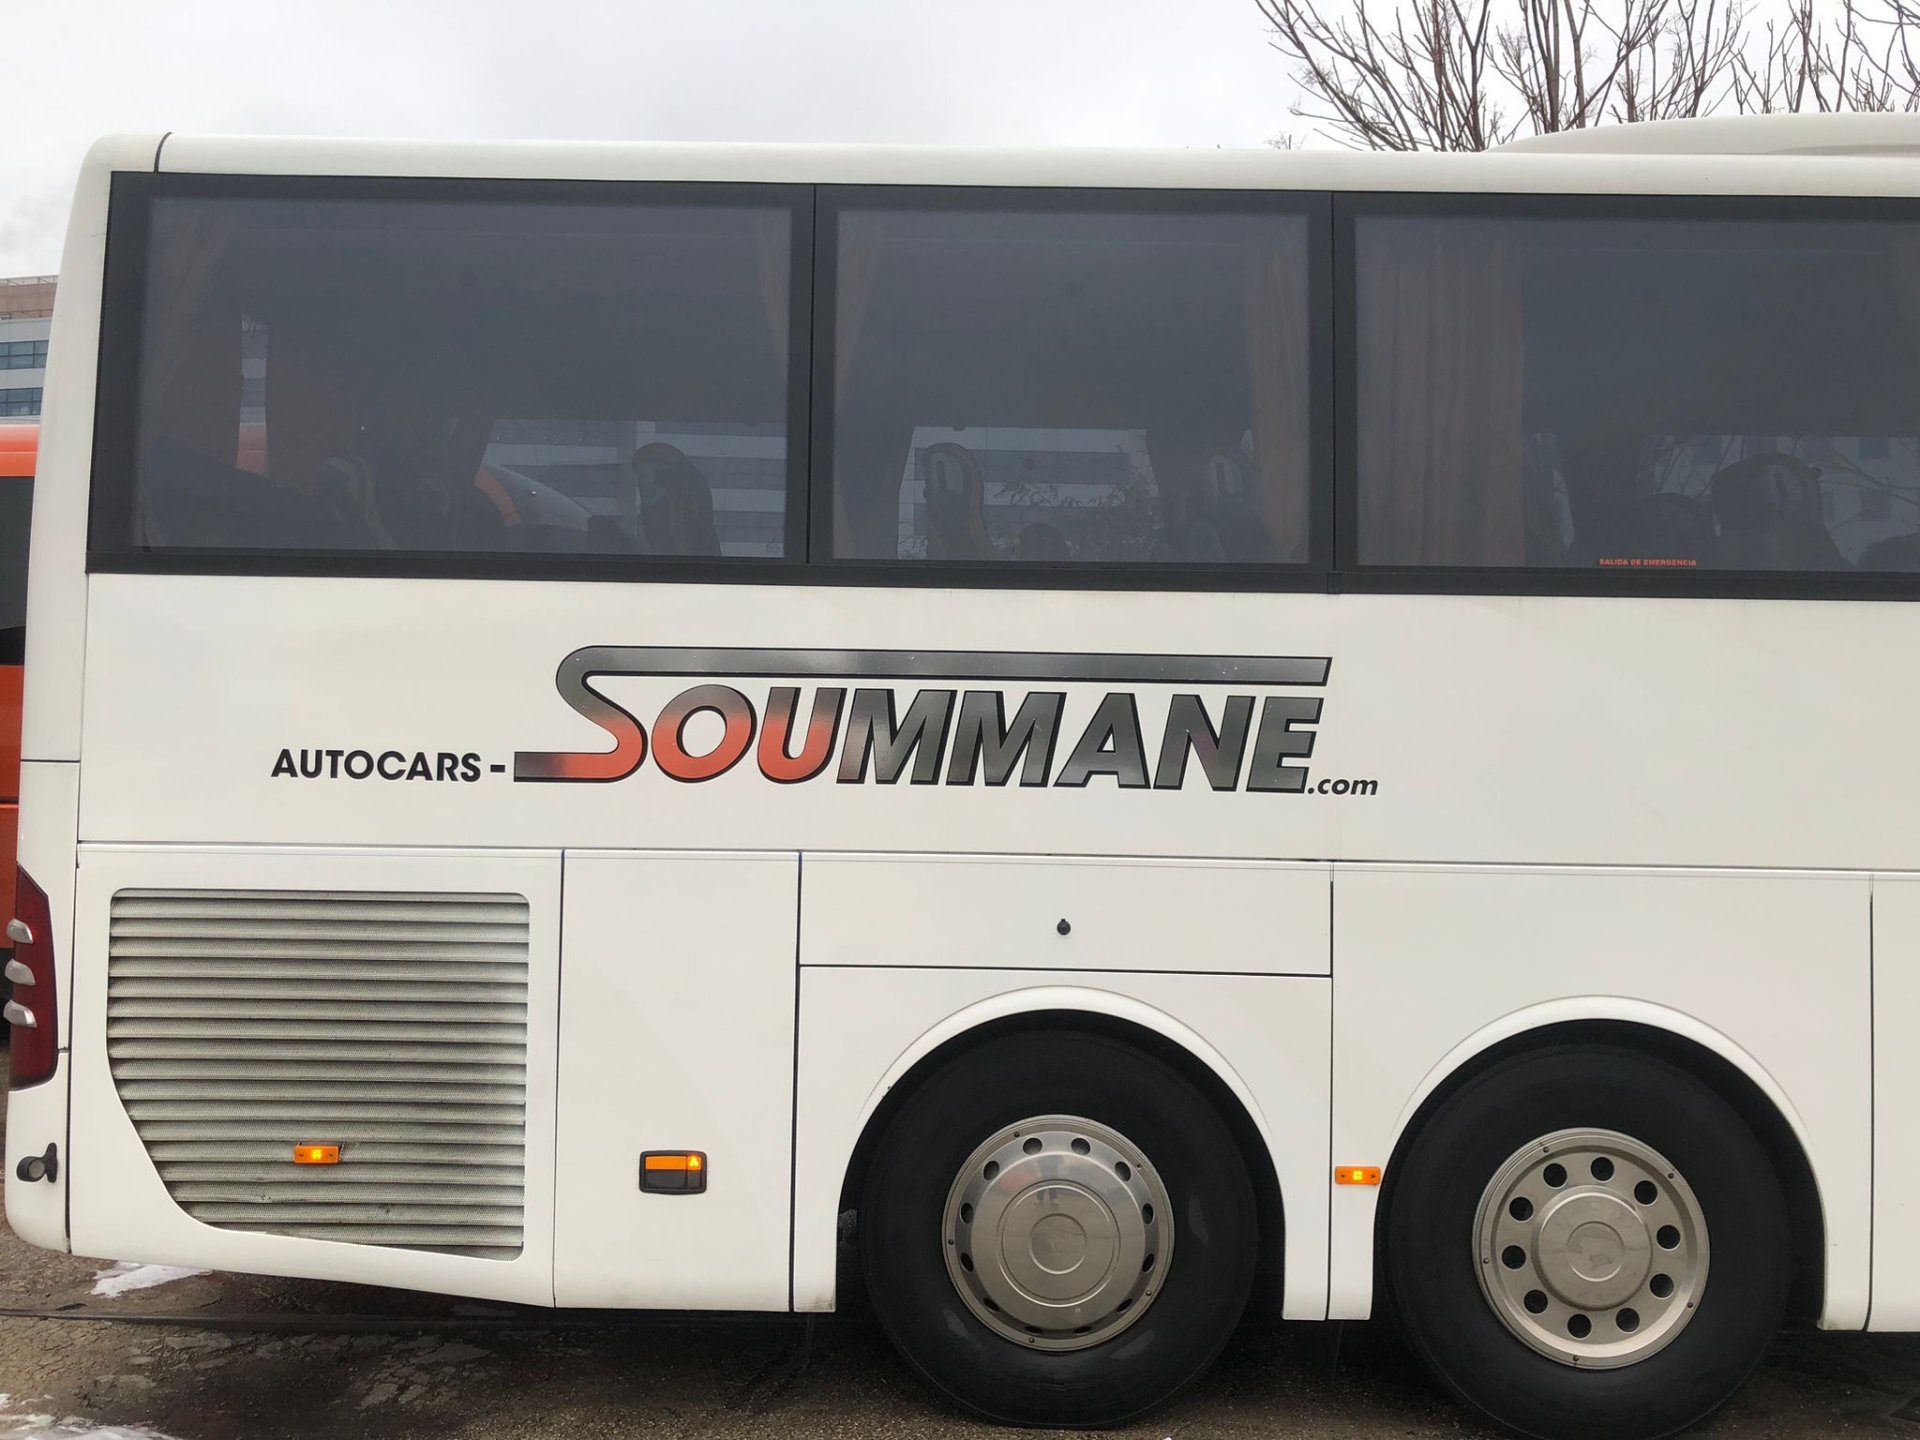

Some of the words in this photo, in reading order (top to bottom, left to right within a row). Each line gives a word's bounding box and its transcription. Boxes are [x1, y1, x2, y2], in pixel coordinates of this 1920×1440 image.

[1600, 558, 1629, 567] SALIDA
[1630, 558, 1641, 567] DE
[1643, 558, 1697, 567] EMERGENCIA
